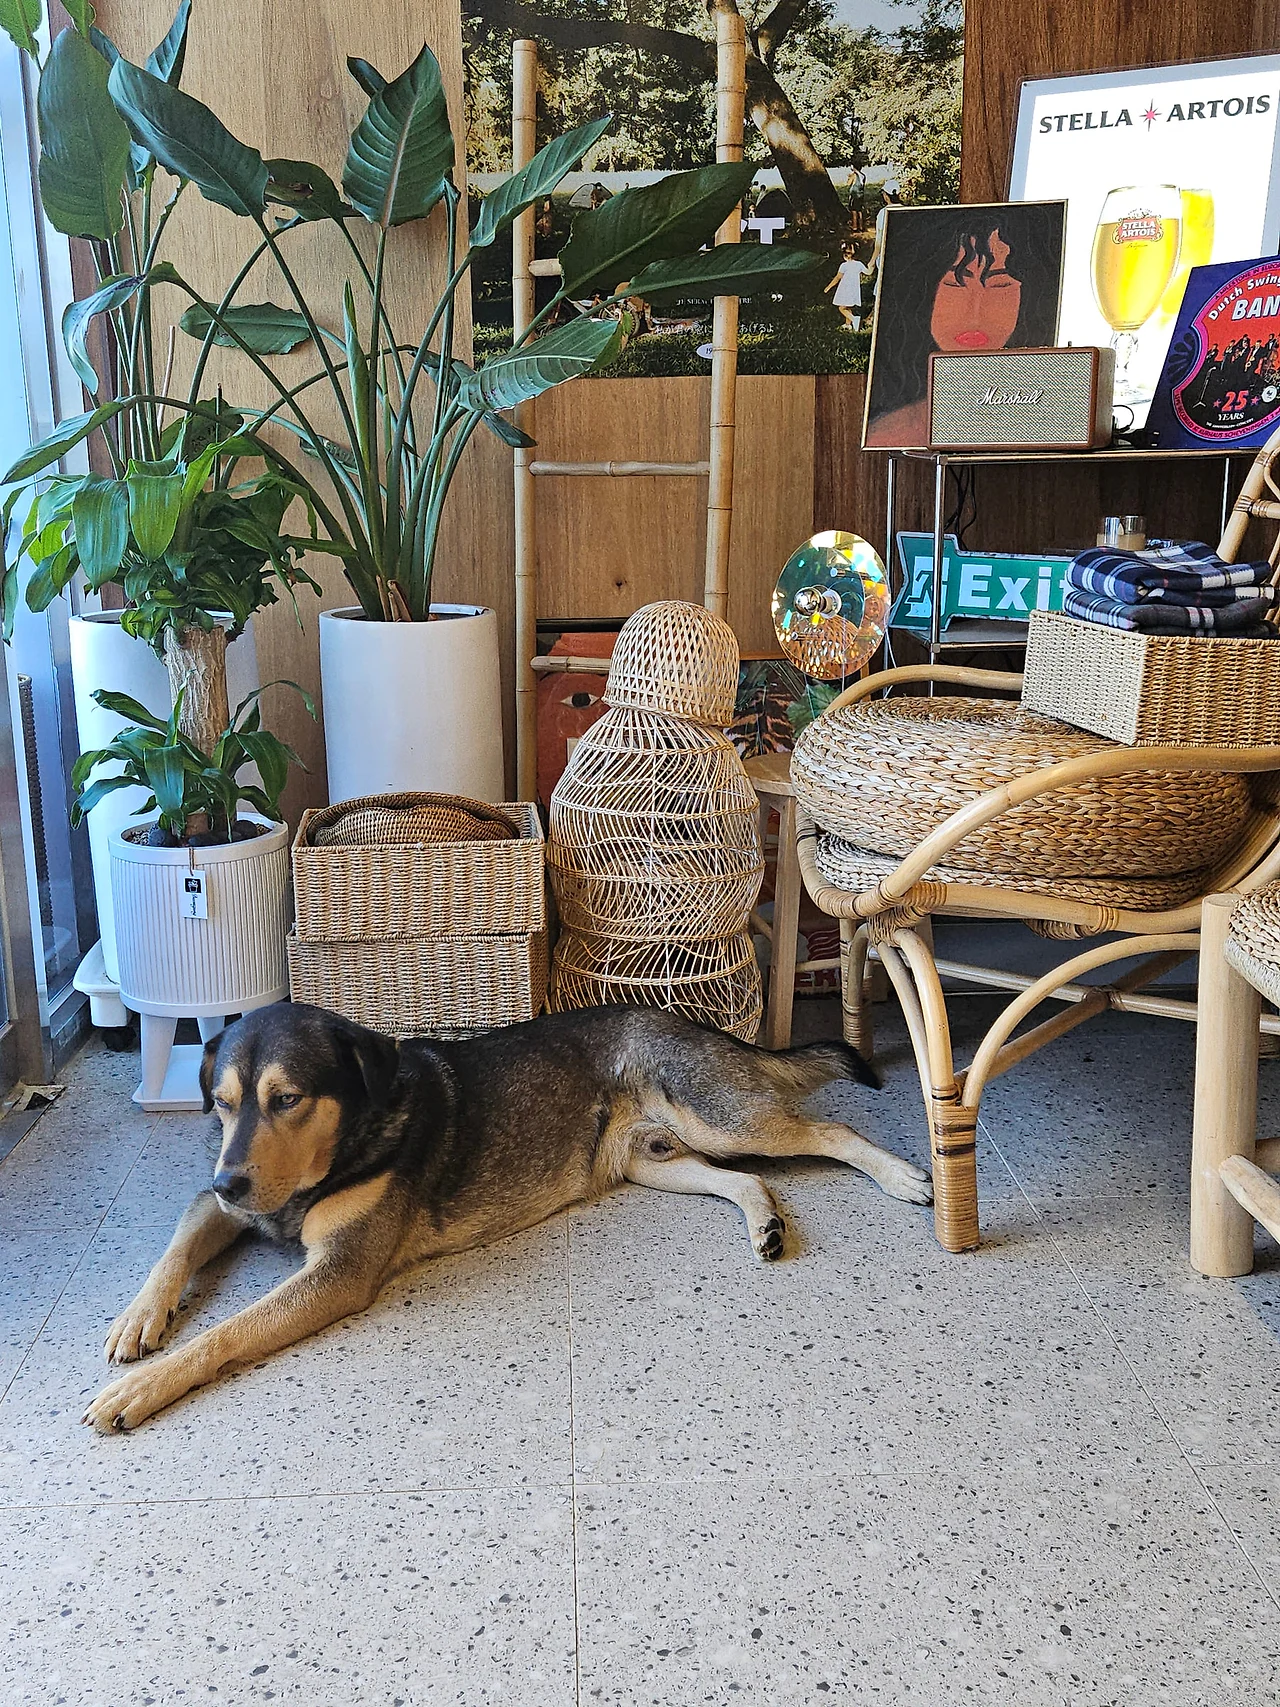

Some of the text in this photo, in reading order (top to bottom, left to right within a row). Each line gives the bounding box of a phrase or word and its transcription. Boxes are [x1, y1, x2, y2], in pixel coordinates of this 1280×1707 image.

[1039, 95, 1270, 134] STELLA ARTOIS
[1121, 228, 1156, 238] ARTOIS
[1122, 220, 1156, 230] STELLA
[1208, 286, 1243, 320] Dutch
[977, 386, 1044, 405] Marshall
[1221, 389, 1249, 411] 25
[1218, 412, 1245, 421] YEARS
